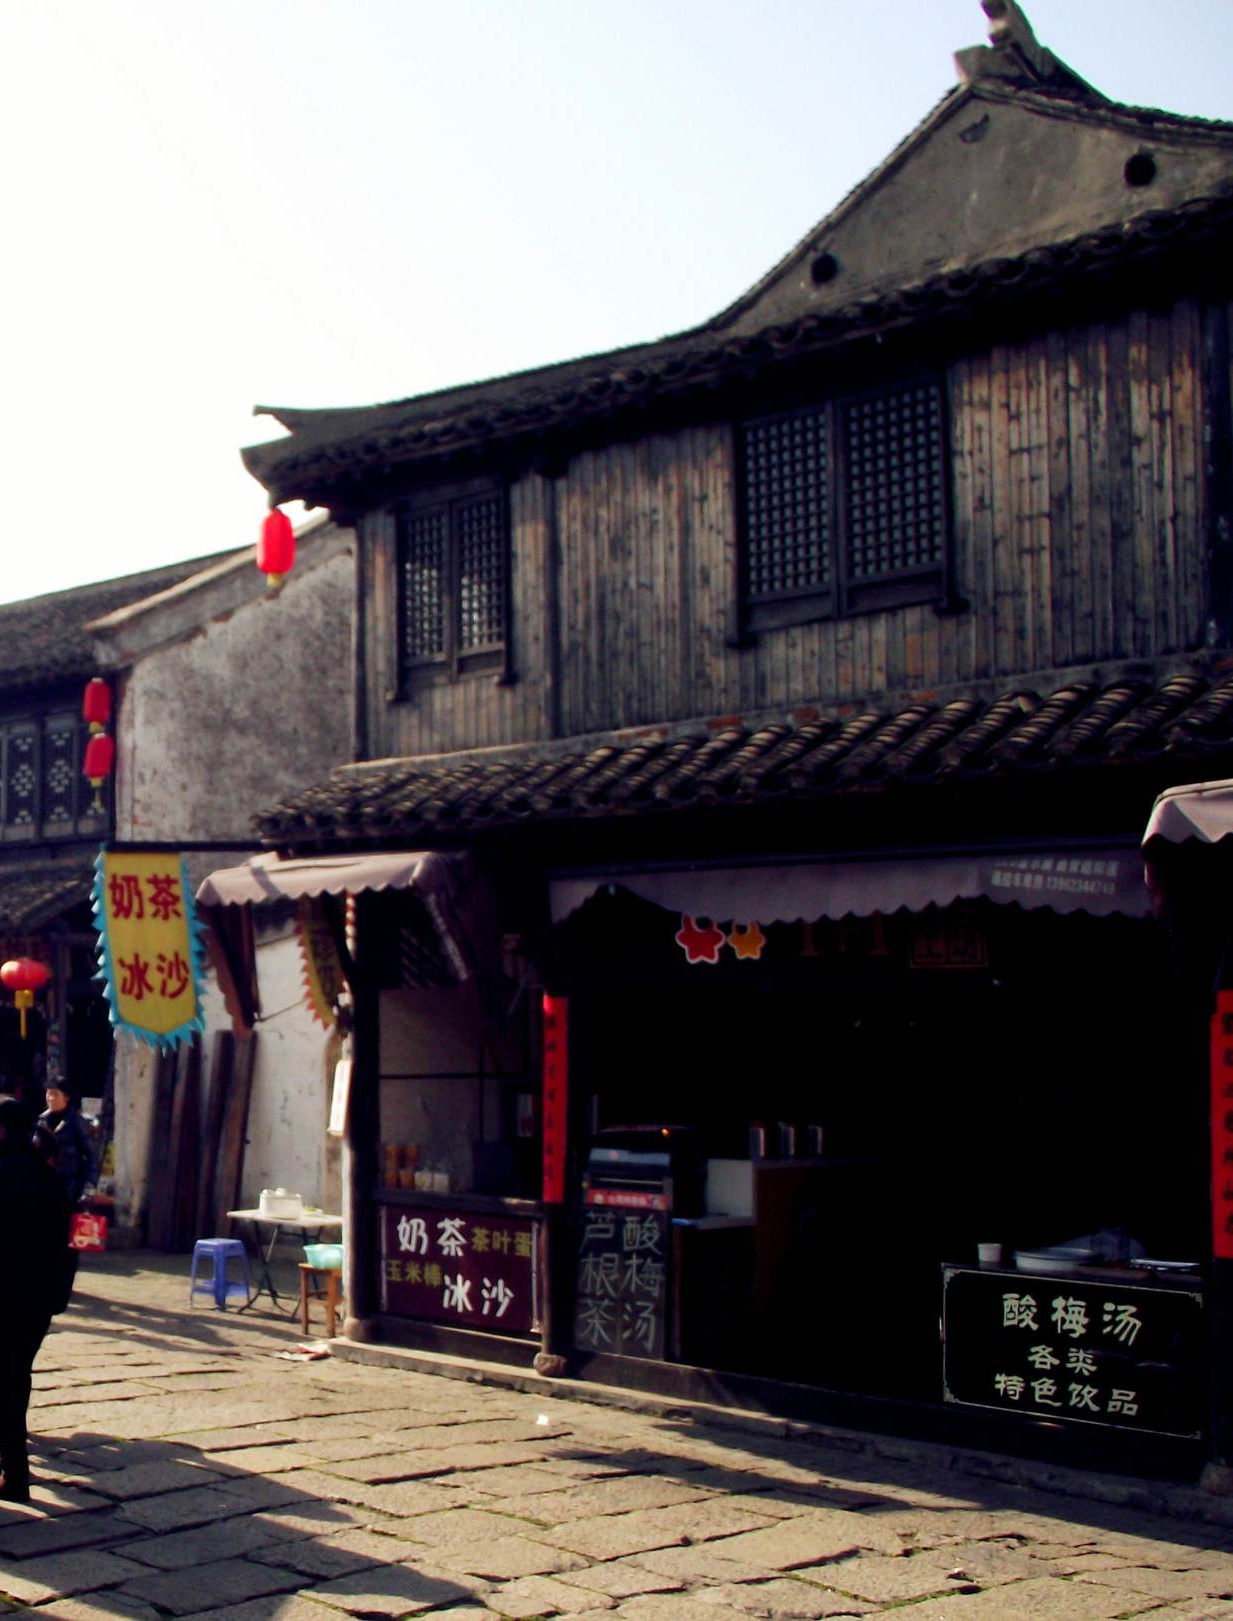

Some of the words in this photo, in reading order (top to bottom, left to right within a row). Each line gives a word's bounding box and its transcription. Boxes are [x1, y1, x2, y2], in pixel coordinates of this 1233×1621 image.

[108, 873, 182, 921] 奶茶
[117, 951, 190, 1000] 冰沙
[396, 1214, 467, 1257] 奶茶
[471, 1226, 532, 1258] 茶叶蛋
[442, 1273, 515, 1318] 冰沙
[580, 1210, 619, 1345] 芦根茶
[619, 1214, 665, 1350] 酸梅汤
[1002, 1293, 1142, 1347] 酸梅汤
[1028, 1344, 1098, 1376] 各类
[994, 1373, 1140, 1416] 特色饮品
